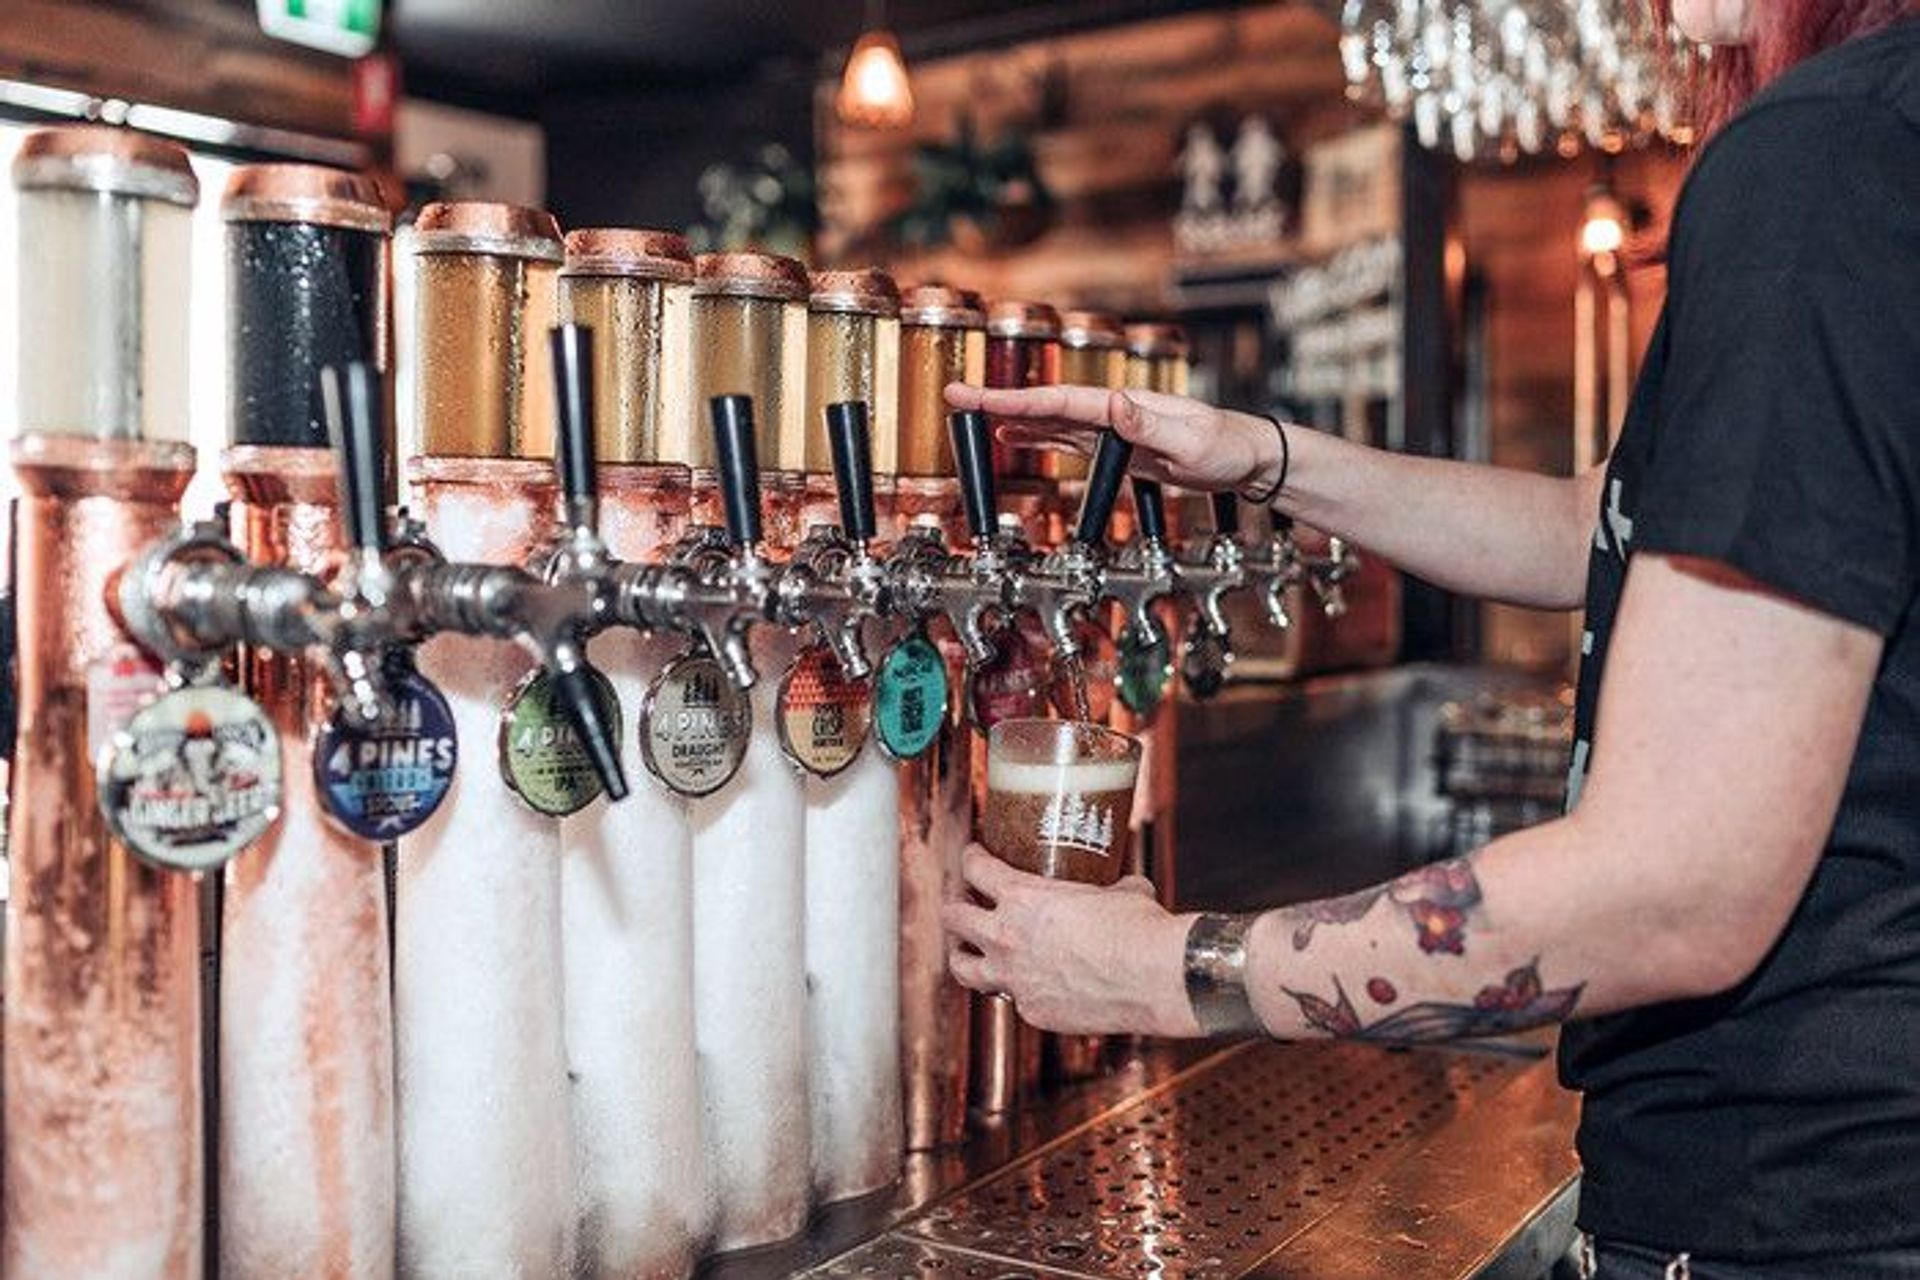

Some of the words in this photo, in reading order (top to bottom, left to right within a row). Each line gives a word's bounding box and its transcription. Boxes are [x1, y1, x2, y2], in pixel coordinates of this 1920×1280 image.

[328, 741, 351, 776] 4
[360, 738, 454, 770] PINES
[672, 743, 725, 758] DRAUGHT
[554, 776, 577, 791] IPA
